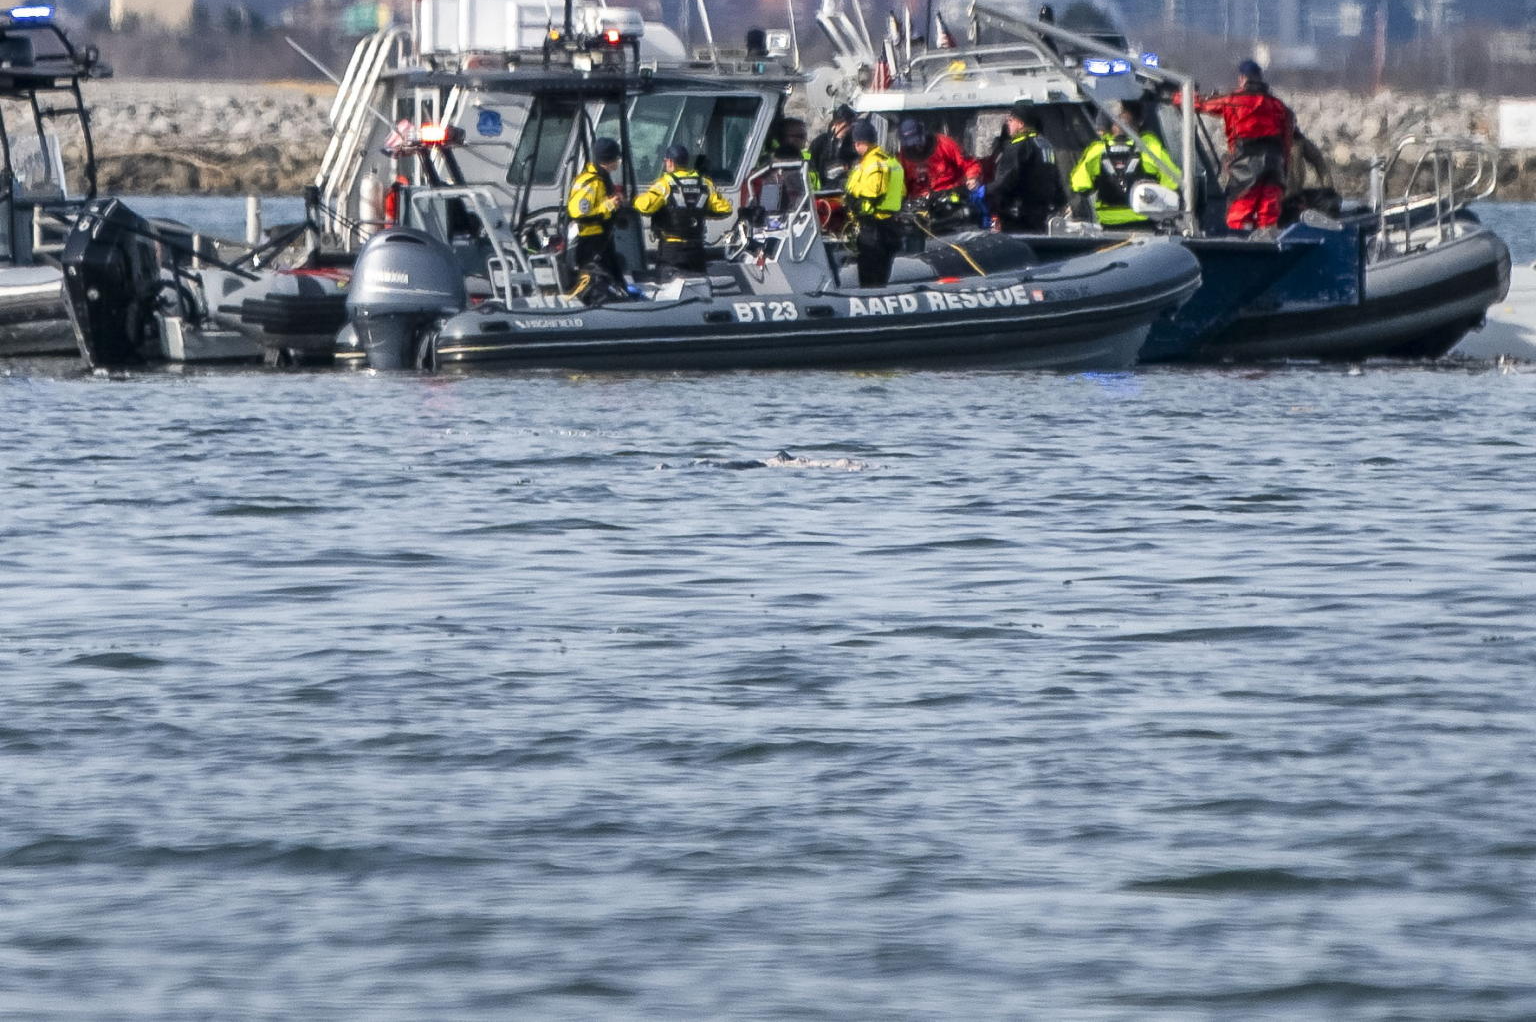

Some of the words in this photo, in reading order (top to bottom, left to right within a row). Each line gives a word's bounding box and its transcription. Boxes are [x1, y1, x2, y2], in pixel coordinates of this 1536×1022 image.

[734, 301, 766, 323] BT
[768, 301, 798, 321] 23
[850, 294, 919, 317] AAFD
[925, 284, 1030, 312] RESCUE
